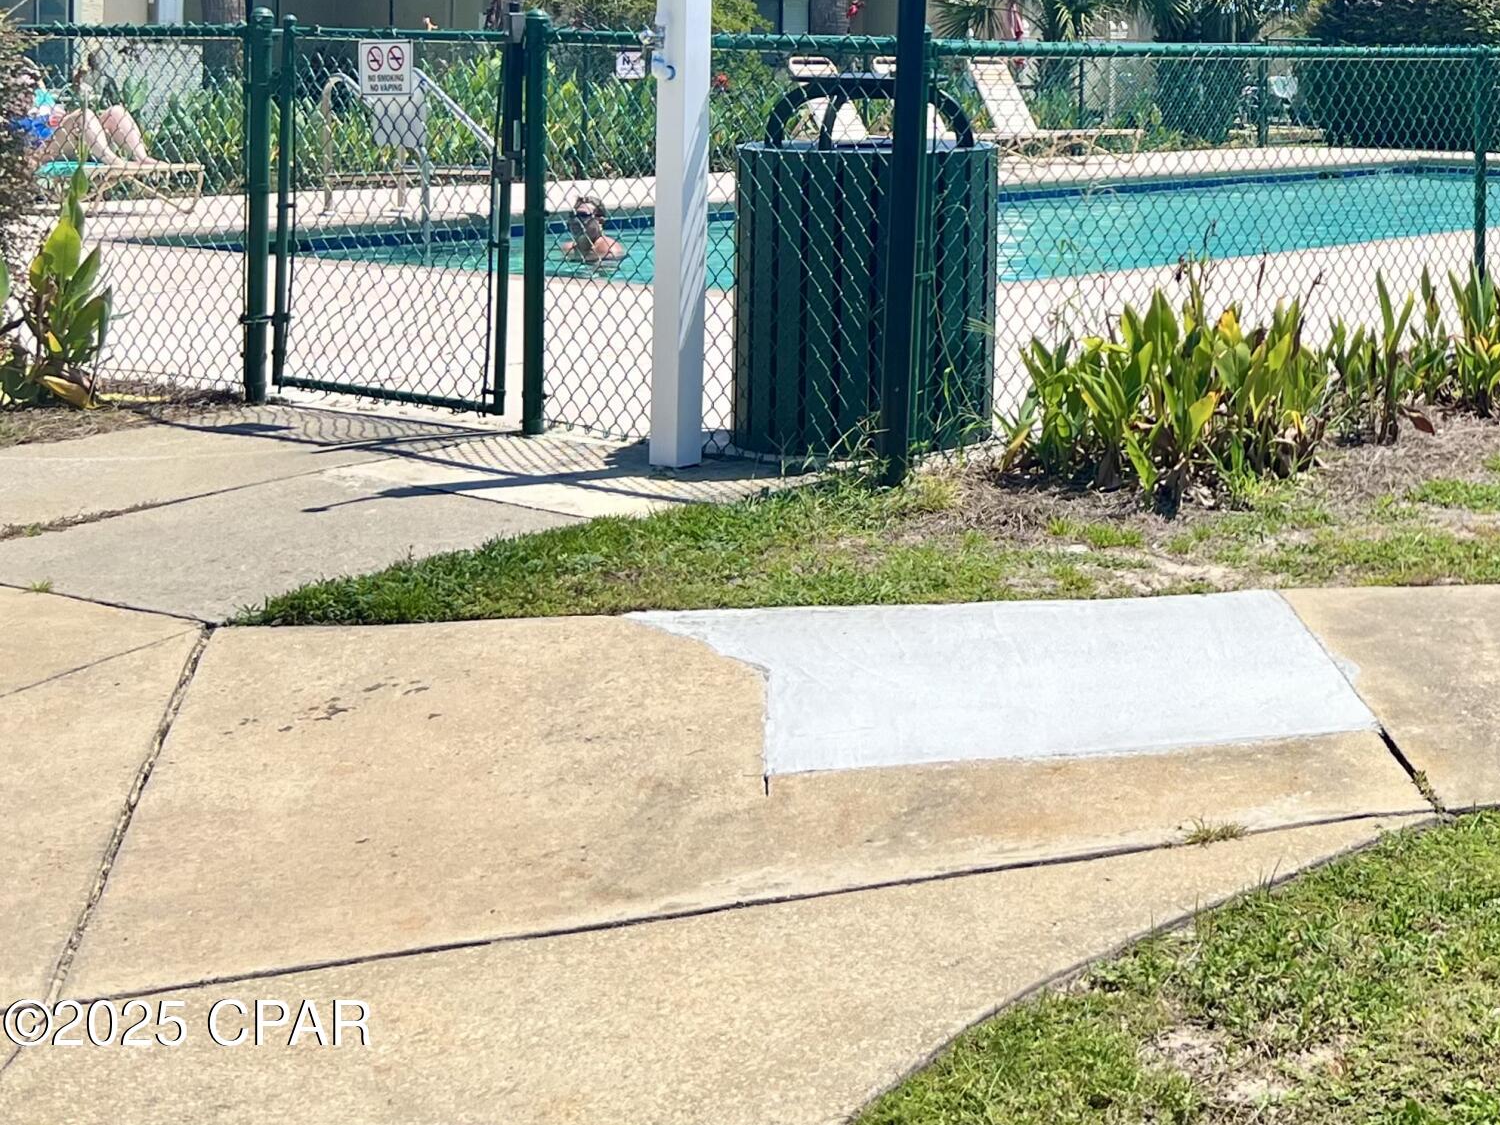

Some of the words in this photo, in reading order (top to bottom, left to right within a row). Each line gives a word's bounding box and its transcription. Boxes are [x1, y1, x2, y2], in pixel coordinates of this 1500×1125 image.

[368, 74, 376, 82] NO
[377, 74, 404, 82] SMOKING
[370, 83, 379, 92] NO
[380, 83, 403, 92] VAPING
